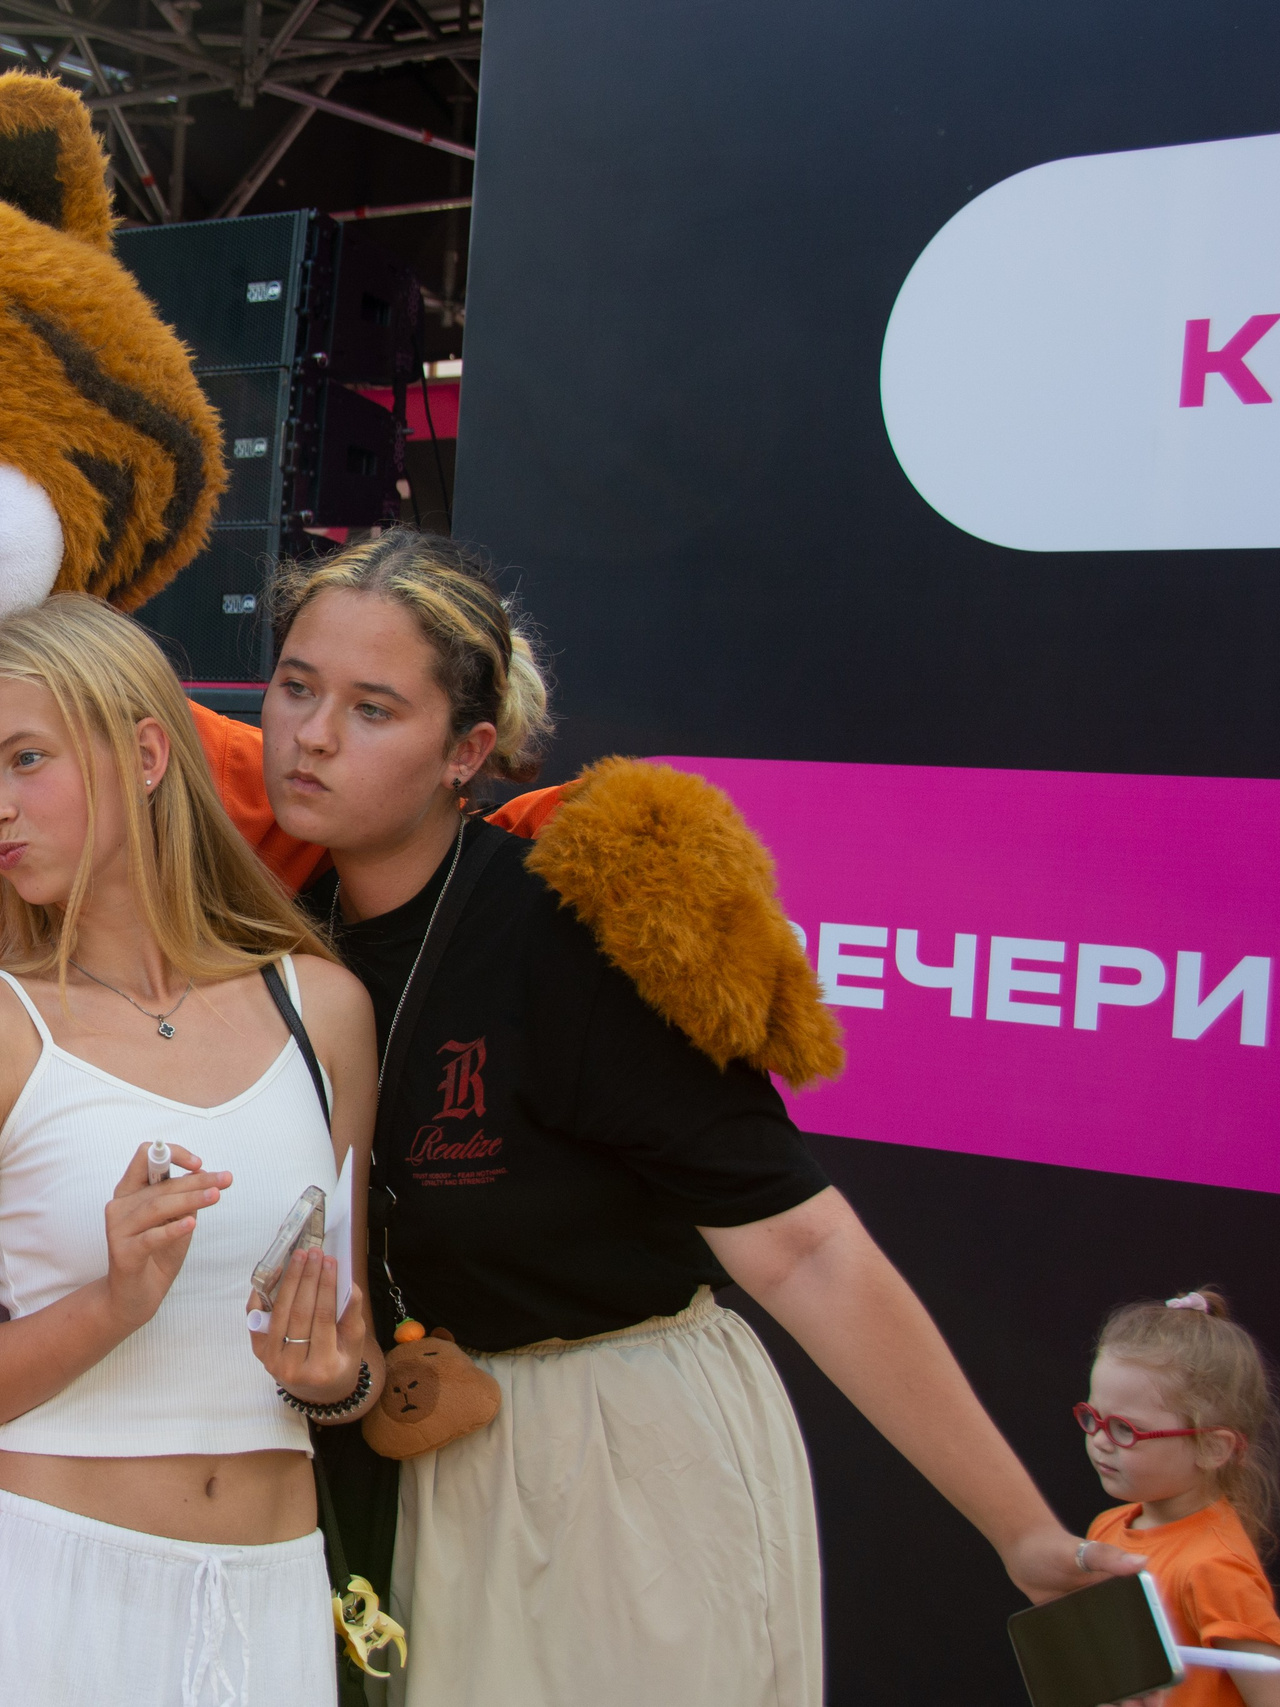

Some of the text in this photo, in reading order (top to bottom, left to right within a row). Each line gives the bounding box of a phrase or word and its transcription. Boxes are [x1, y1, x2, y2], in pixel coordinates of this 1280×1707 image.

[1179, 313, 1280, 408] К
[786, 920, 1272, 1047] ЕЧЕРИ
[405, 1124, 503, 1167] Realize
